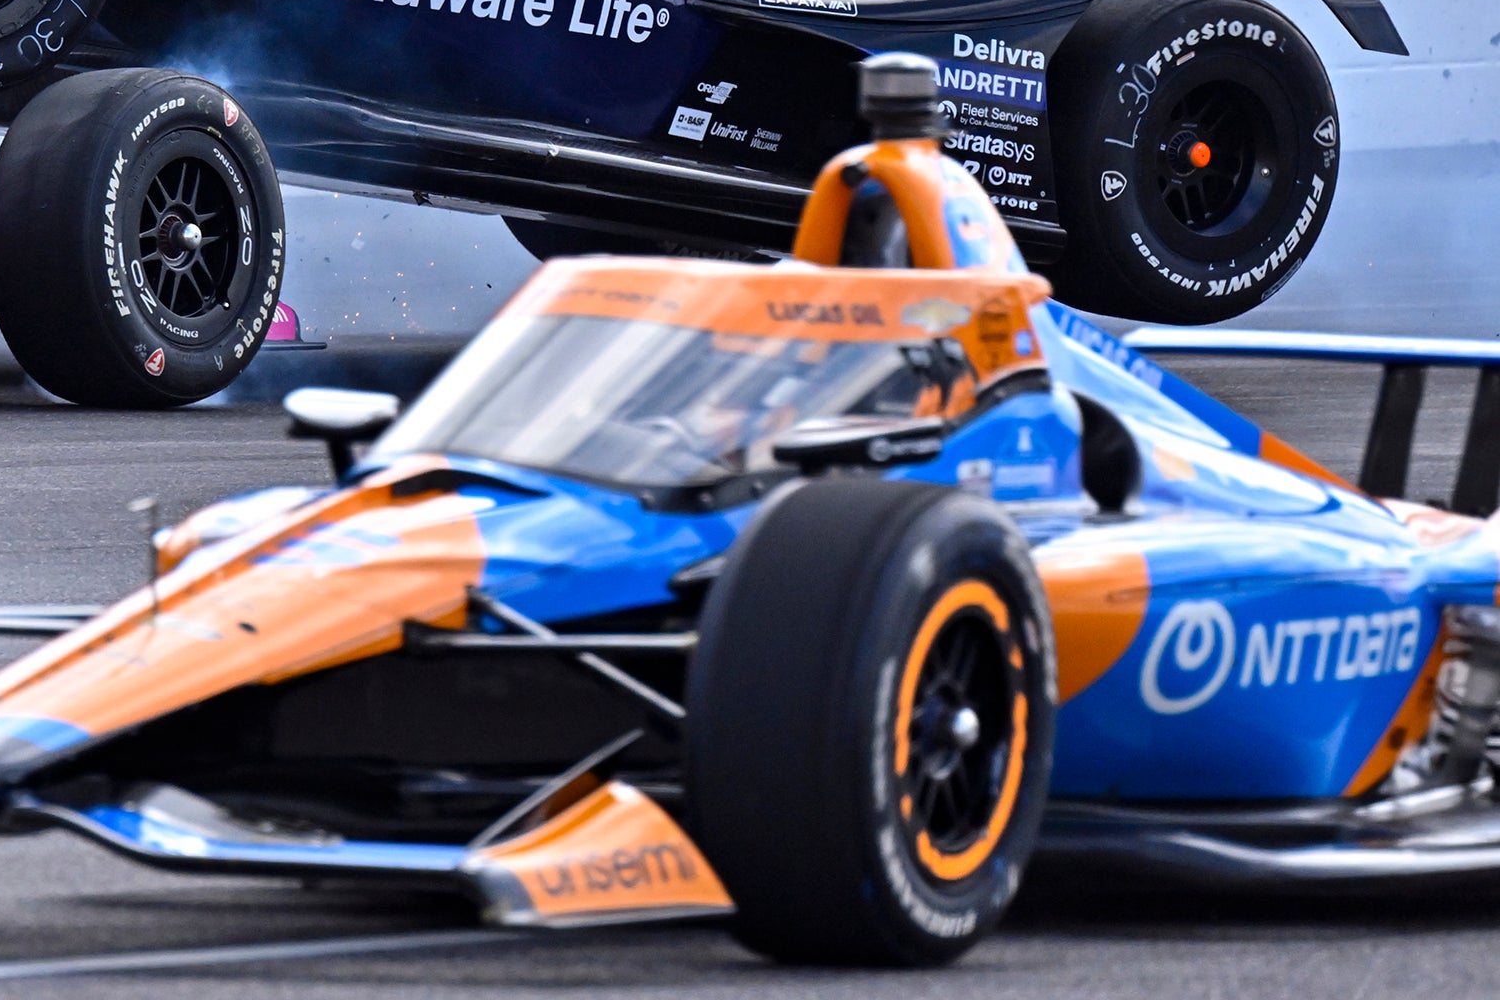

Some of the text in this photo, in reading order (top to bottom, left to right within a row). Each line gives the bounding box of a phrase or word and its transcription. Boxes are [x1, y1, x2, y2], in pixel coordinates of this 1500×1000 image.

[953, 33, 1046, 70] Delivra
[1146, 18, 1277, 76] Firestone
[132, 106, 161, 141] INDY
[159, 97, 186, 113] 500
[687, 115, 706, 126] BASF
[960, 116, 1018, 132] by Cox Automotive
[961, 103, 1039, 127] Fleet Services
[710, 121, 748, 142] UniFirst
[750, 137, 779, 152] WILLIAMS
[754, 127, 783, 142] SHERWIN
[943, 130, 1035, 163] stratasys
[213, 147, 244, 195] RACING
[1007, 171, 1032, 187] NTT
[103, 150, 132, 317] FIREHAWK
[1204, 173, 1325, 298] FIREHAWK
[1130, 231, 1202, 292] INDY 500
[234, 228, 284, 360] Firestone
[159, 316, 200, 340] RACING
[766, 300, 886, 327] LUCAS OIL
